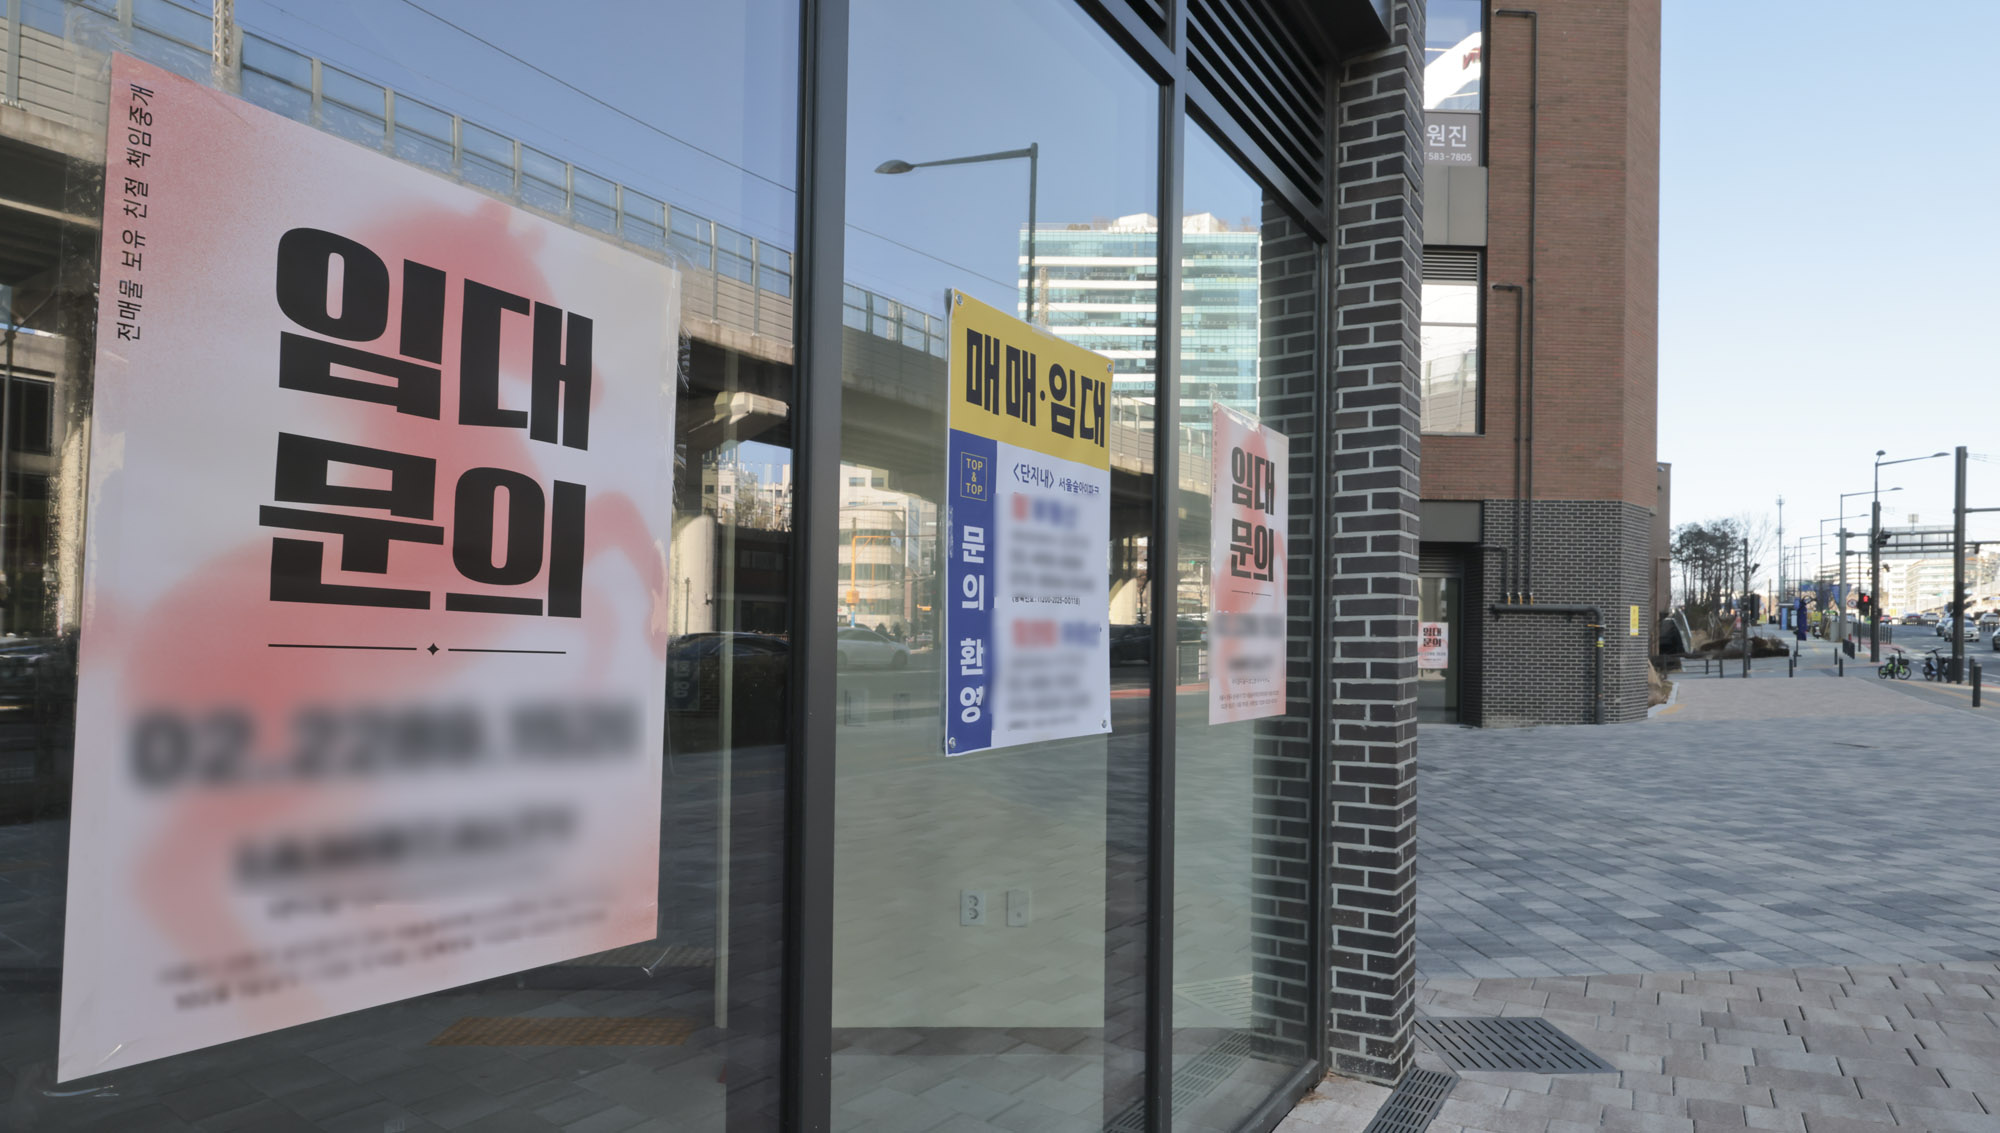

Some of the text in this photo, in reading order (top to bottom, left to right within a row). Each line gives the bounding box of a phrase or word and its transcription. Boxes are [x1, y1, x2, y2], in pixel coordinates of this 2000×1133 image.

[1426, 124, 1467, 148] 원진
[1428, 152, 1472, 162] 583-7805
[116, 83, 155, 342] 전매물 보유 친절 책임중개
[276, 227, 593, 451] 임대
[966, 457, 983, 471] TOP
[971, 471, 977, 482] &
[1231, 446, 1275, 515] 임대
[965, 482, 983, 495] TOP
[259, 432, 587, 618] 문의
[1230, 518, 1275, 582] 문의
[1423, 627, 1442, 637] 임대
[1423, 638, 1442, 648] 문의
